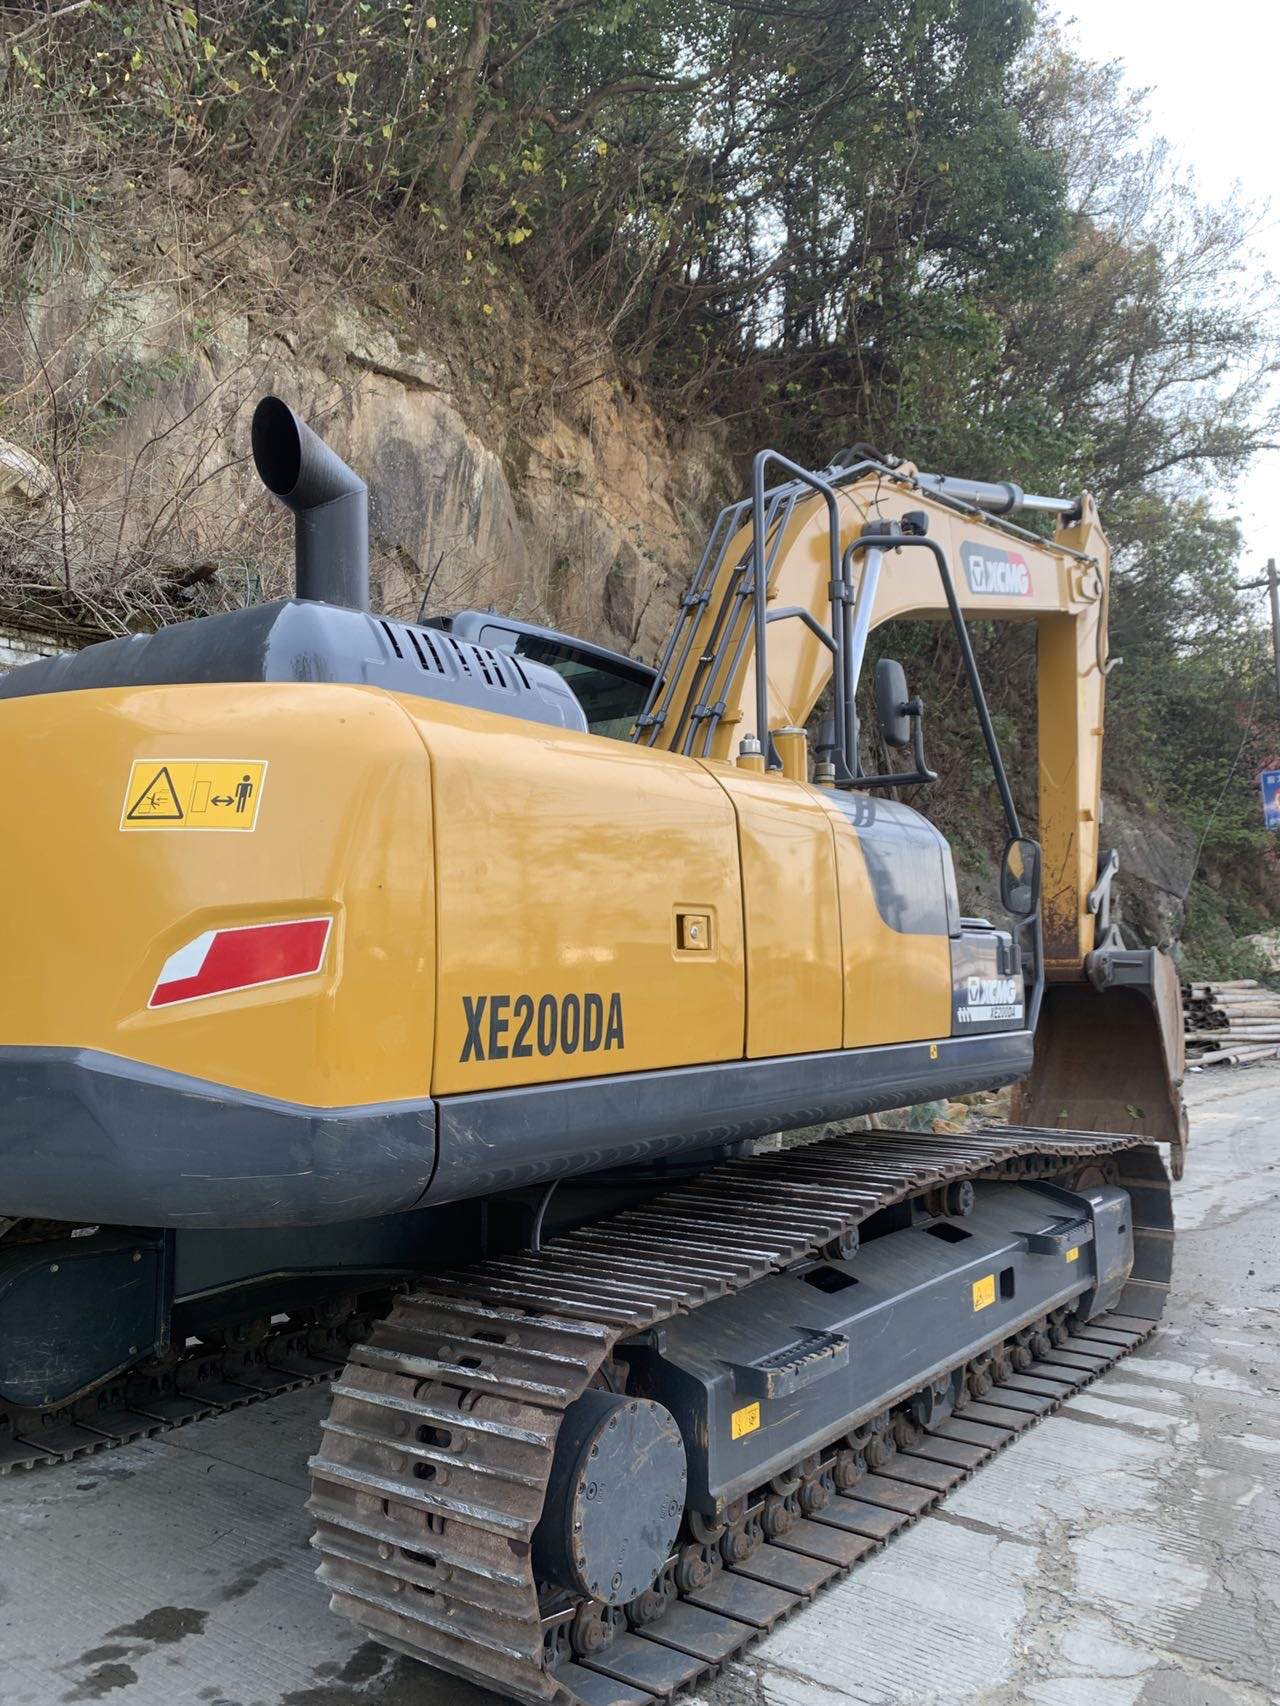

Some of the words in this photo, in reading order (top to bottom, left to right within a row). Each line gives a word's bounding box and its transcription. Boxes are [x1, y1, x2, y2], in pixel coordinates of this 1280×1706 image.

[985, 560, 1029, 594] XCMG
[980, 978, 1016, 1004] XCMG
[459, 992, 625, 1063] XE200DA
